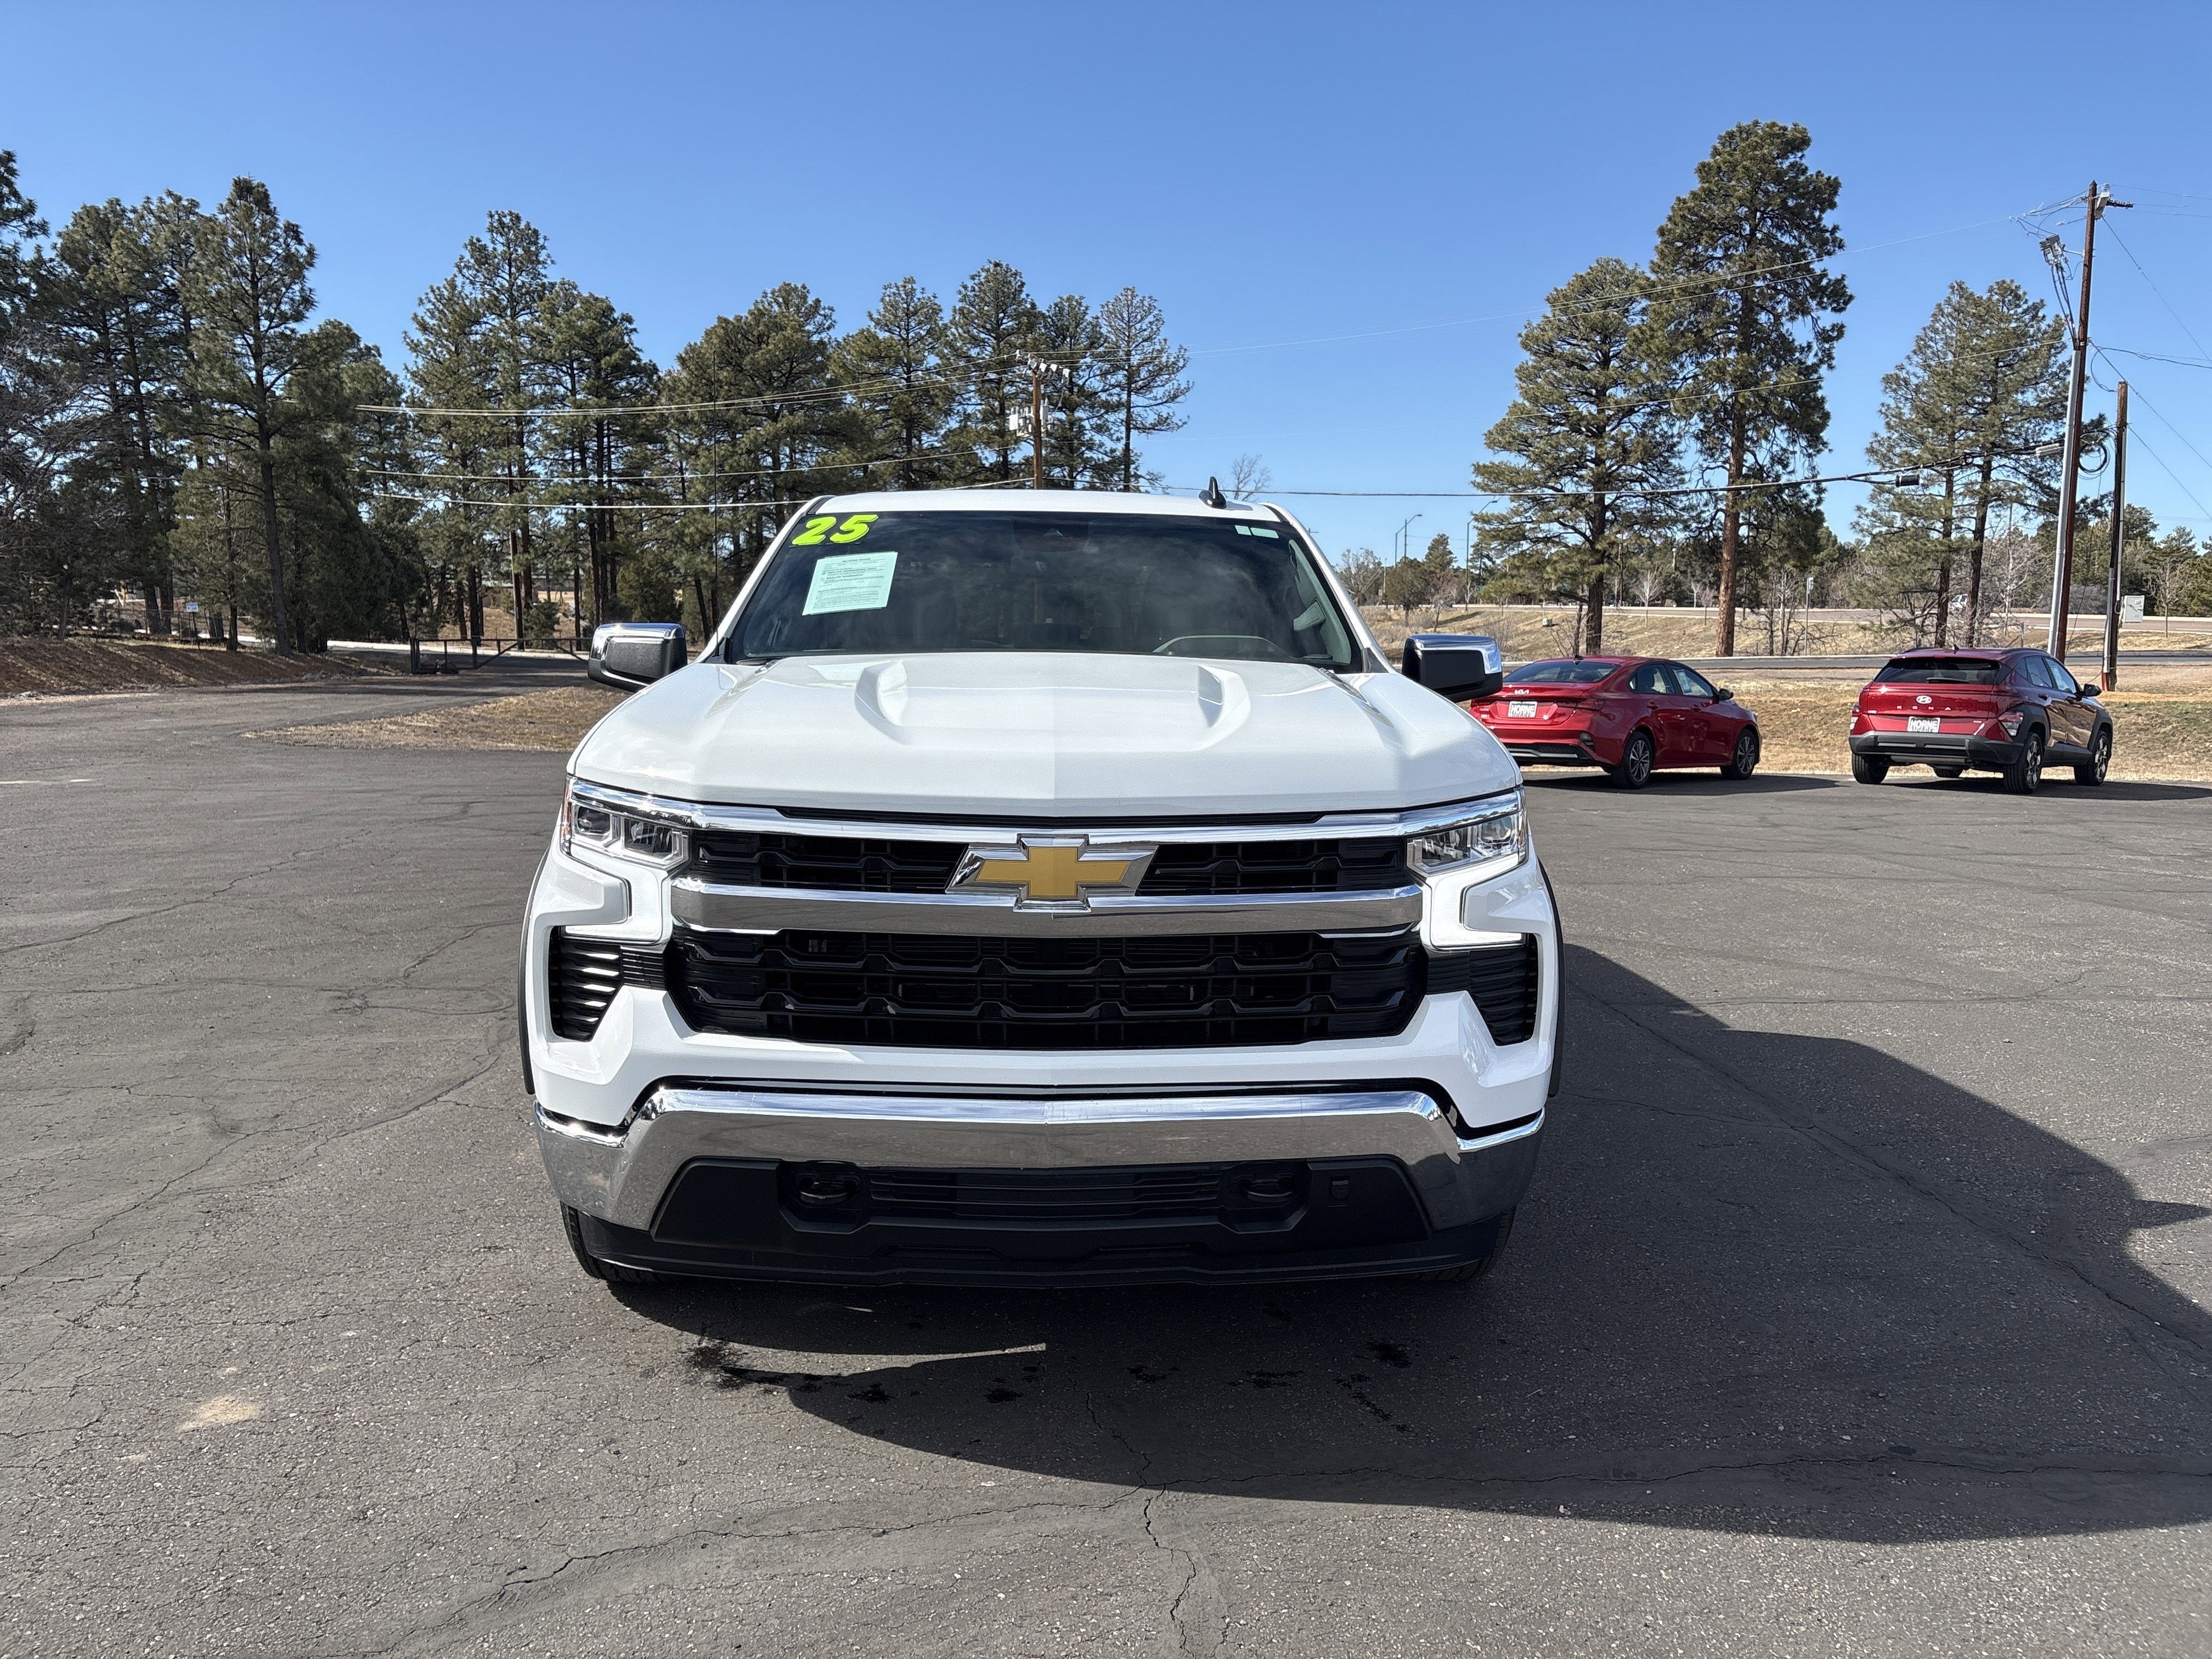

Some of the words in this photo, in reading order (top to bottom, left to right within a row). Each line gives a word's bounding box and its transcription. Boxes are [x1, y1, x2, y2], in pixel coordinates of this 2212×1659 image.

[792, 514, 879, 545] 25
[1510, 704, 1536, 714] HORNE
[1910, 719, 1938, 730] HORNE
